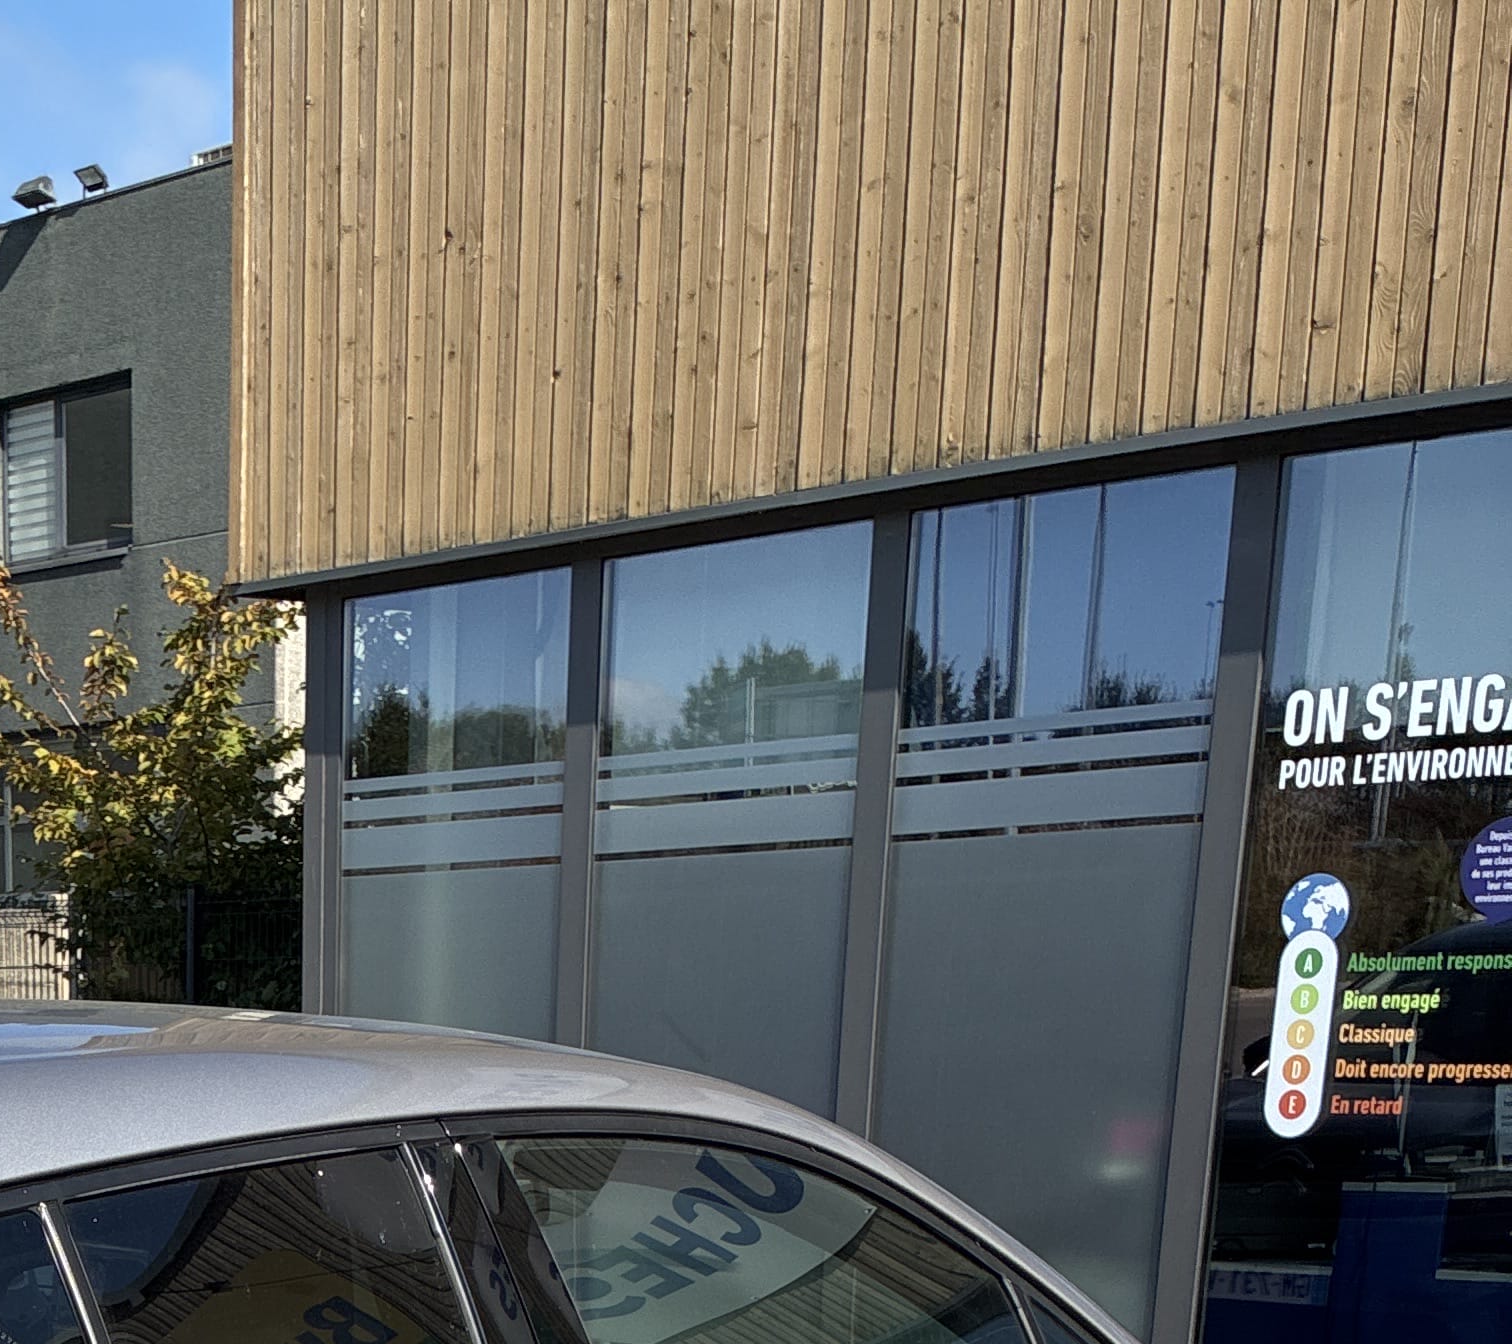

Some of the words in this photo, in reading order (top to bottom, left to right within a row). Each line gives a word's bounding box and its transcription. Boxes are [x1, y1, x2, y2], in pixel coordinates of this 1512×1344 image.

[1283, 686, 1349, 748] ON
[1362, 673, 1512, 742] S'ENG
[1278, 755, 1346, 791] POUR
[1303, 954, 1313, 973] A
[1347, 952, 1443, 973] Absolument
[1300, 991, 1309, 1009] B
[1342, 989, 1378, 1010] Bien
[1381, 988, 1441, 1013] engagé
[1295, 1025, 1305, 1044] C
[1338, 1023, 1416, 1047] Classique
[1291, 1056, 1302, 1078] D
[1334, 1058, 1366, 1079] Doit
[1369, 1062, 1425, 1079] encore
[1288, 1095, 1298, 1114] E
[1330, 1095, 1349, 1115] En
[1353, 1096, 1404, 1116] retard
